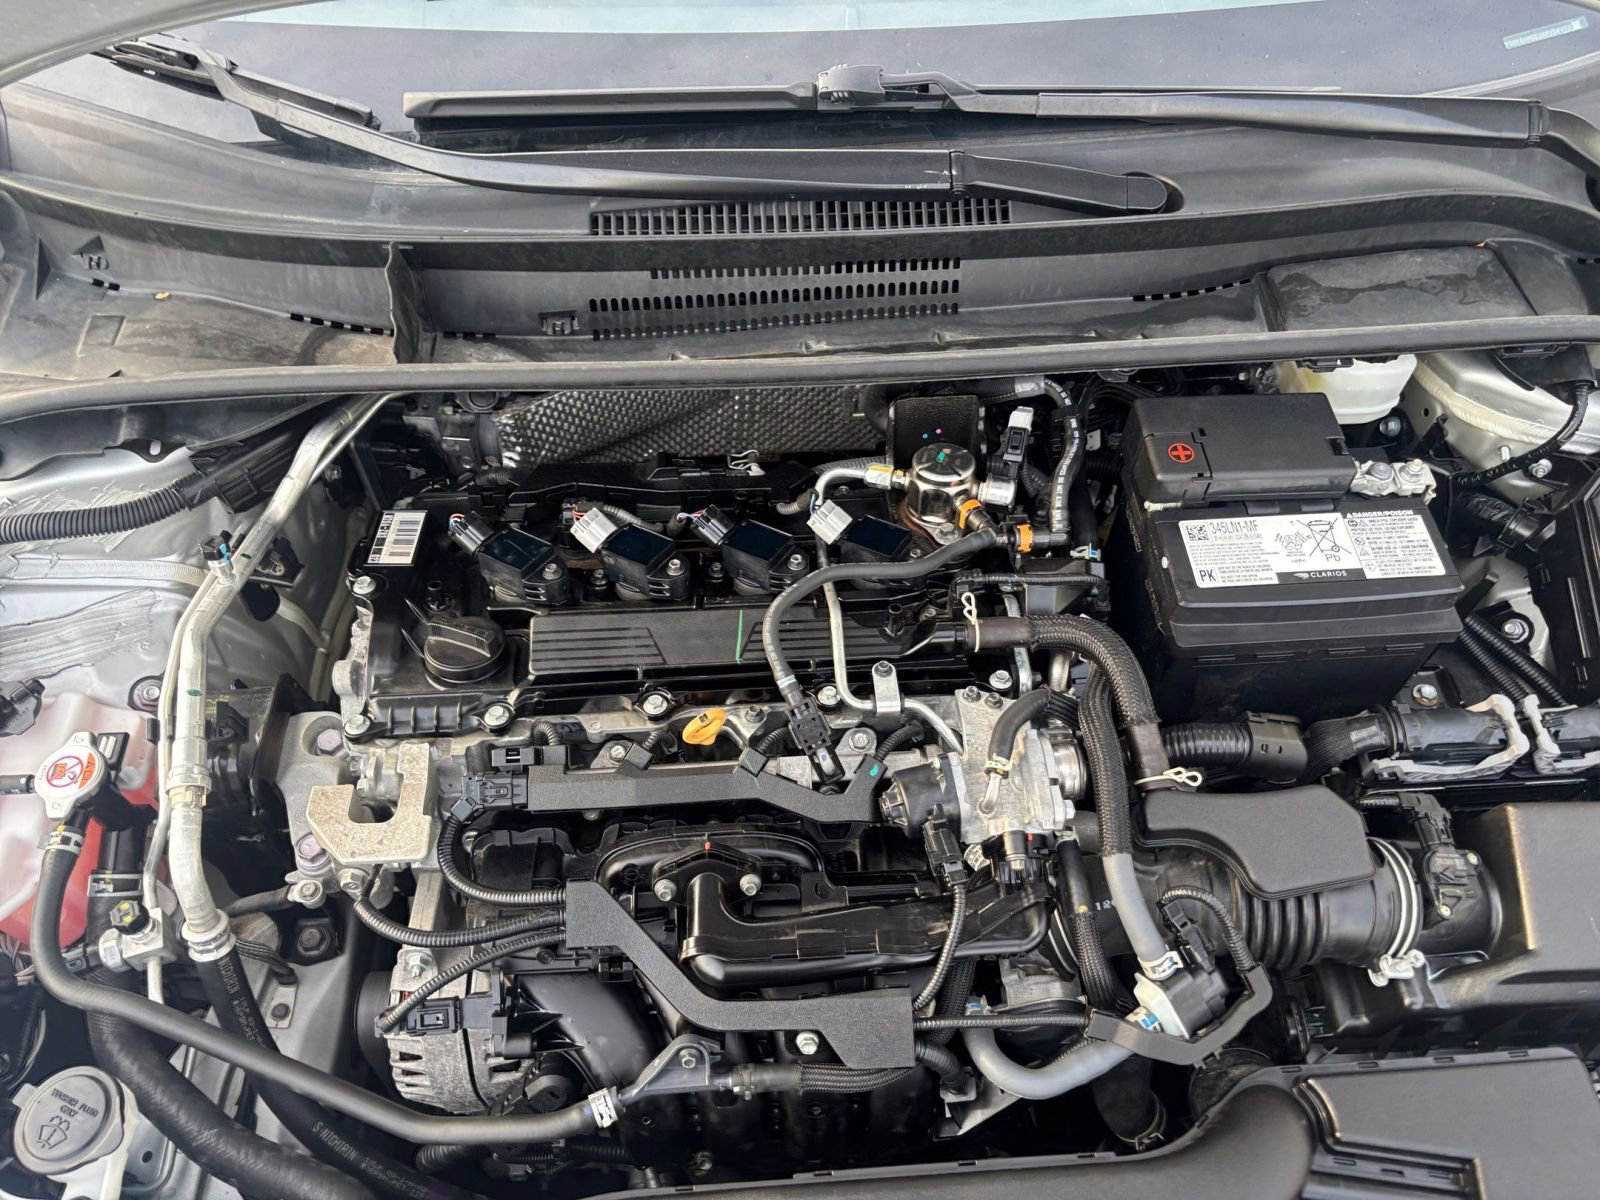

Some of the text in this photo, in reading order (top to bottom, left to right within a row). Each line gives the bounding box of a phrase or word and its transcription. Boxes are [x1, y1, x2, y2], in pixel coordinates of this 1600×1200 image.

[1325, 553, 1341, 562] Pb
[1199, 568, 1217, 583] PK
[1310, 570, 1348, 578] CLARIOS
